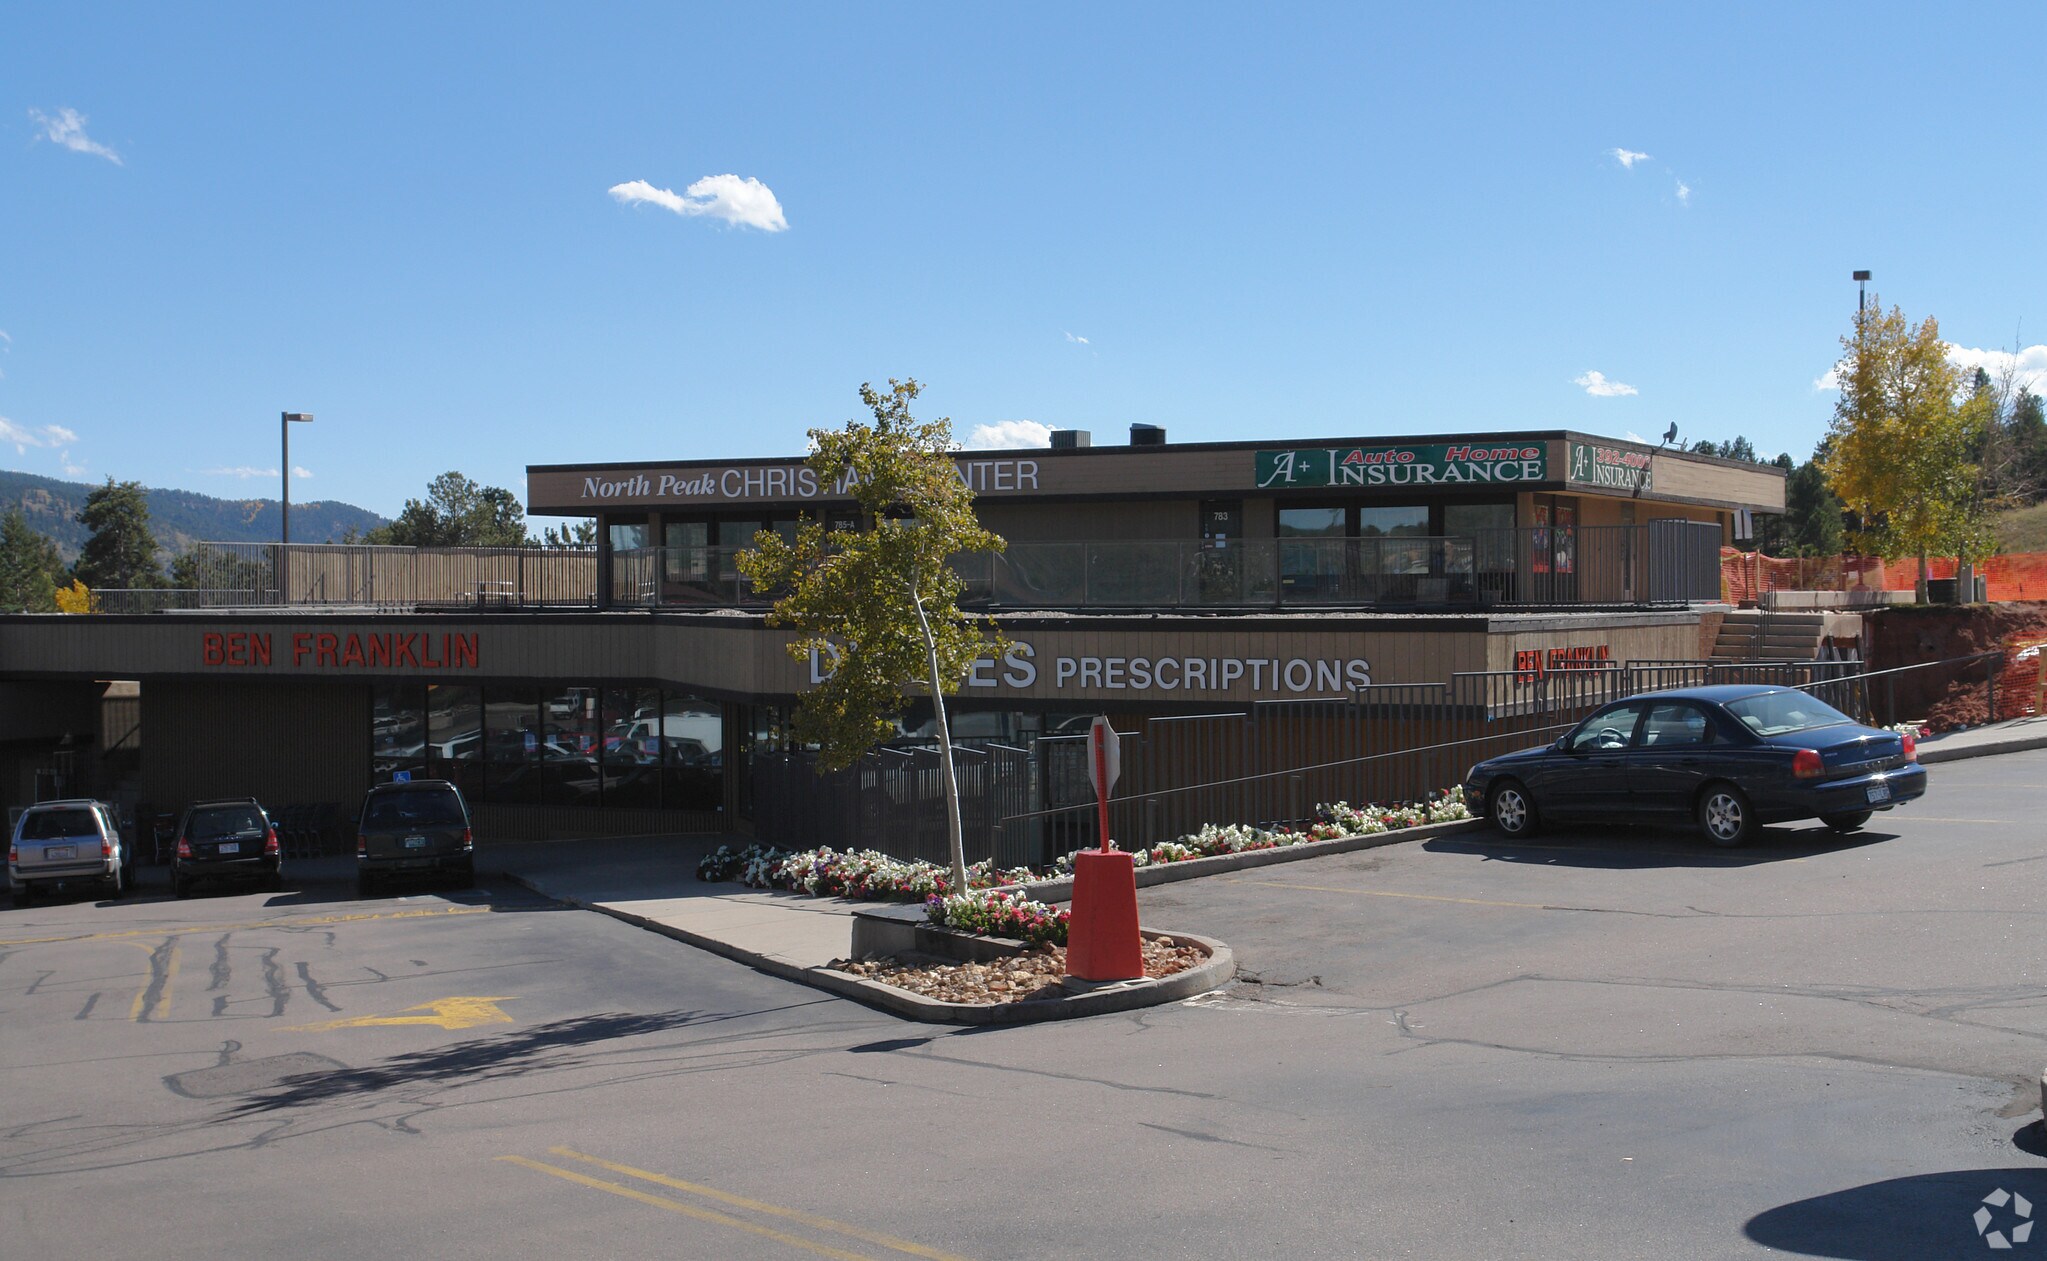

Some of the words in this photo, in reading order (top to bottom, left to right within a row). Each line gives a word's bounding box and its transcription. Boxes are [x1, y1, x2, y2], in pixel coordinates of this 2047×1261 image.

[1257, 451, 1310, 488] A+
[1326, 449, 1544, 486] INSURANCE
[1342, 449, 1415, 465] Auto
[1444, 446, 1540, 462] Home
[1592, 446, 1652, 490] INSURANCE
[581, 474, 650, 498] North
[656, 473, 716, 496] Peak
[1214, 511, 1228, 521] 783
[203, 632, 272, 667] BEN
[293, 632, 479, 668] FRANKLIN
[1517, 650, 1543, 684] BEN
[1056, 657, 1371, 692] PRESCRIPTIONS
